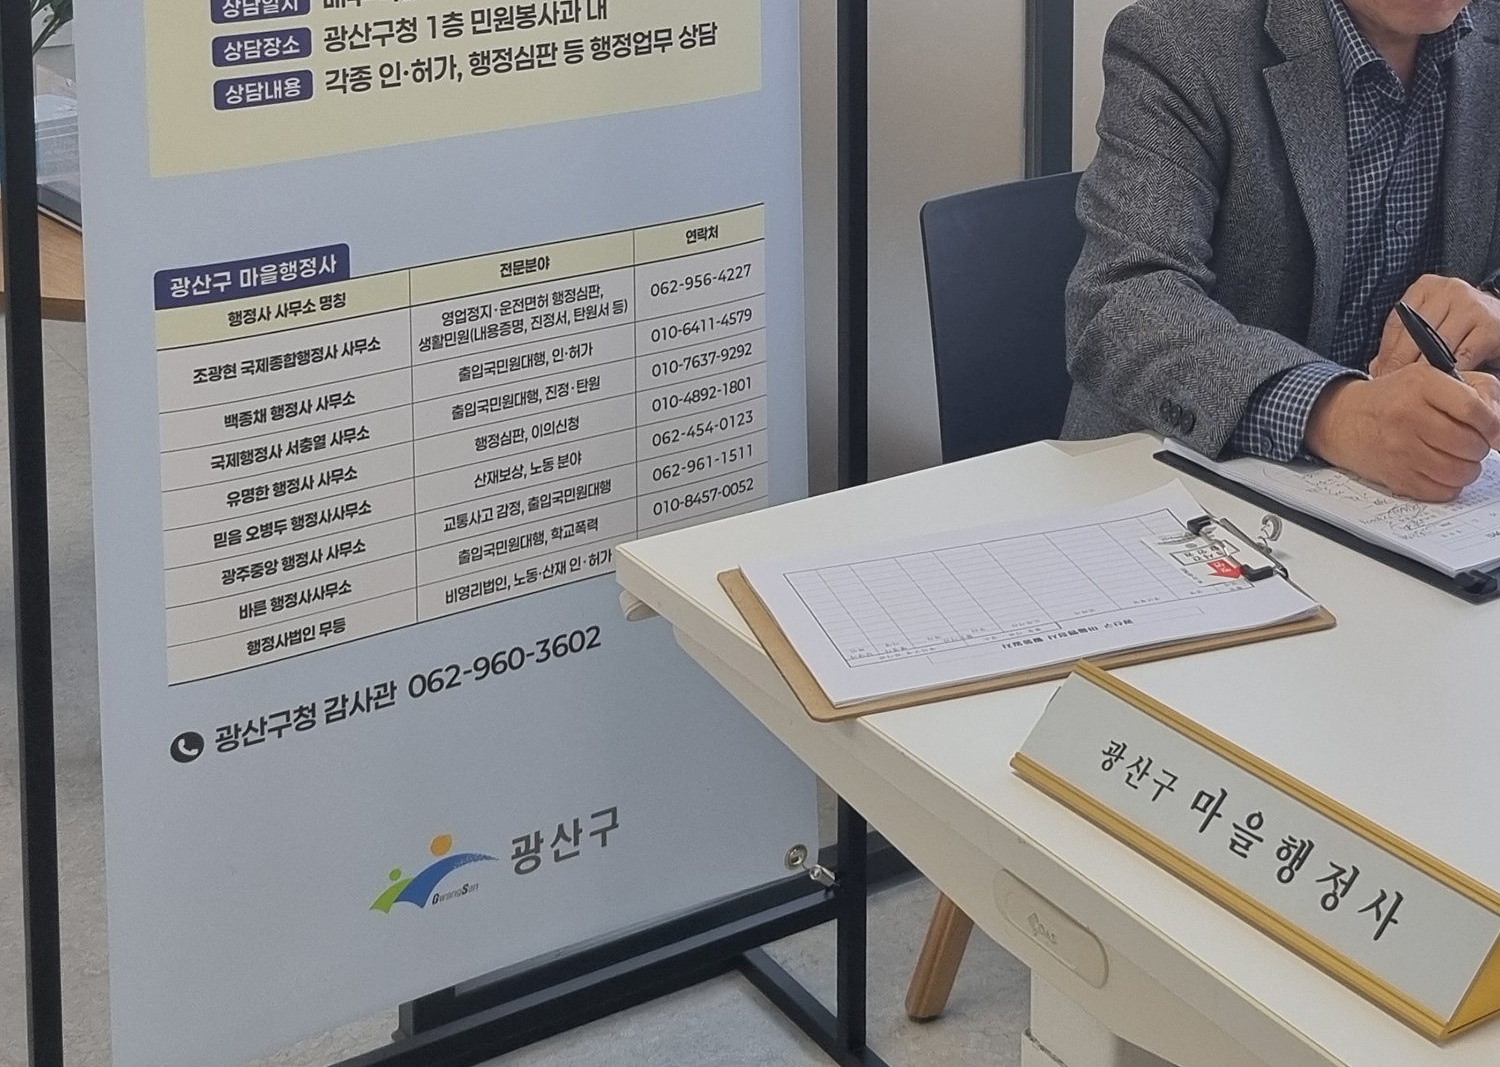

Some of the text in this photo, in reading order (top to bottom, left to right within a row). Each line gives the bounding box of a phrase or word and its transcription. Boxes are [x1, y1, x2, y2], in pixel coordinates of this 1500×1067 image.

[323, 17, 418, 53] 광산구청
[426, 11, 465, 39] 1층
[470, 0, 582, 36] 민원봉사과
[223, 34, 300, 61] 상담장소
[325, 21, 718, 95] 각종 인·허가, 행정심판 등 행정업무 상담
[224, 76, 301, 105] 상담내용
[685, 225, 719, 244] 연락처
[170, 254, 337, 298] 광산구 마을행정사
[499, 256, 550, 278] 전문분야
[650, 263, 752, 297] 062-956-4227
[228, 292, 347, 327] 행정사 사무소 명칭
[551, 284, 604, 309] 행정심판,
[418, 298, 629, 353] 생활민원(내용증명, 진정서, 탄원서 등)
[651, 308, 753, 343] 010-6411-4579
[193, 336, 381, 385] 조광현 국제종합행정사 사무소
[458, 343, 594, 383] 출입국민원대행, 인·허가
[651, 342, 753, 378] 010-7637-9292
[224, 391, 356, 429] 백종채 행정사 사무소
[451, 375, 601, 421] 출입국민원대행, 진정·탄원
[651, 376, 752, 413] 010-4892-1801
[210, 425, 370, 471] 국제행정사 서충열 사무소
[475, 415, 580, 452] 행정심판, 이의신청
[652, 409, 754, 447] 062-454-0123
[474, 451, 582, 489] 산재보상, 노동 분야
[652, 444, 753, 482] 062-961-1511
[226, 466, 358, 508] 유명한 행정사 사무소
[443, 479, 612, 533] 교통사고 감정, 출입국민원대행
[653, 478, 754, 516] 010-8457-0052
[213, 500, 372, 549] 믿음 오병두 행정사사무소
[458, 517, 599, 566] 출입국민원대행, 학교폭력
[221, 539, 366, 585] 광주중앙 행정사 사무소
[445, 550, 613, 604] 비영리법인, 노동·산재 인·허가
[239, 580, 352, 620] 바른 행정사사무소
[246, 617, 347, 656] 행정사법인 무등
[214, 625, 601, 753] 광산구청 감사관 062-960-3602
[510, 806, 619, 876] 광산구
[1101, 739, 1405, 941] 광산구 마을행정사
